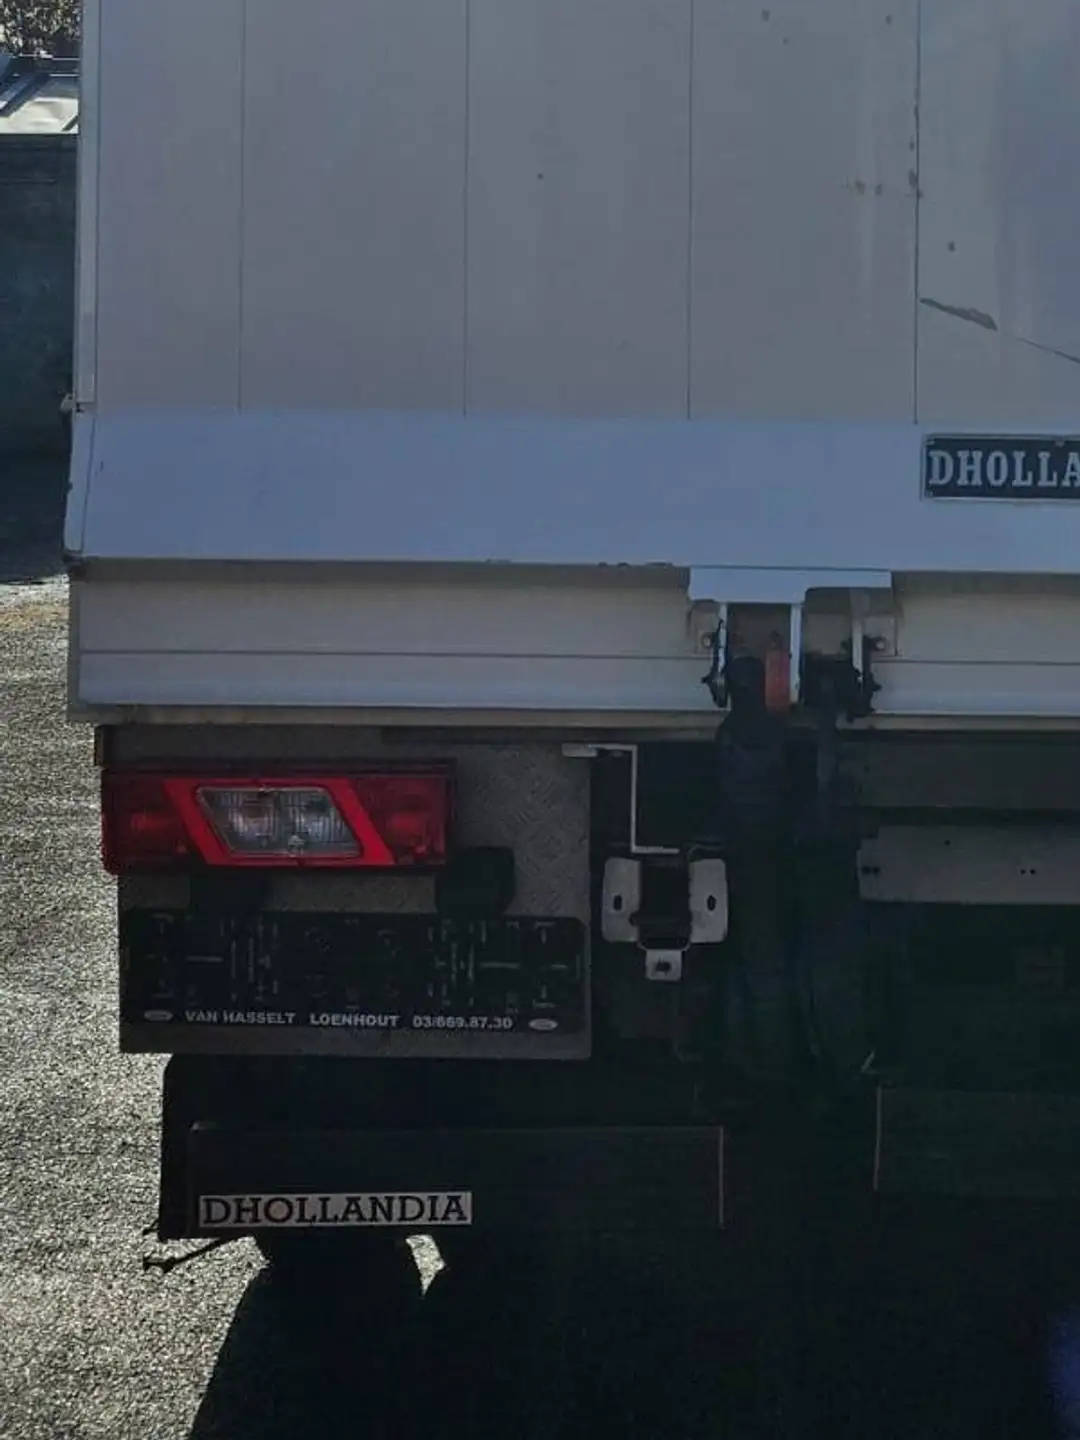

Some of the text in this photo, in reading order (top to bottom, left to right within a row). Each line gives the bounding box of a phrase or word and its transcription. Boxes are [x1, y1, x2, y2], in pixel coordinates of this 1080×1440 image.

[184, 1010, 218, 1023] VAN
[223, 1010, 297, 1025] HASSELT
[310, 1012, 400, 1027] LOENHOUT
[202, 1194, 468, 1225] DHOLLANDIA
